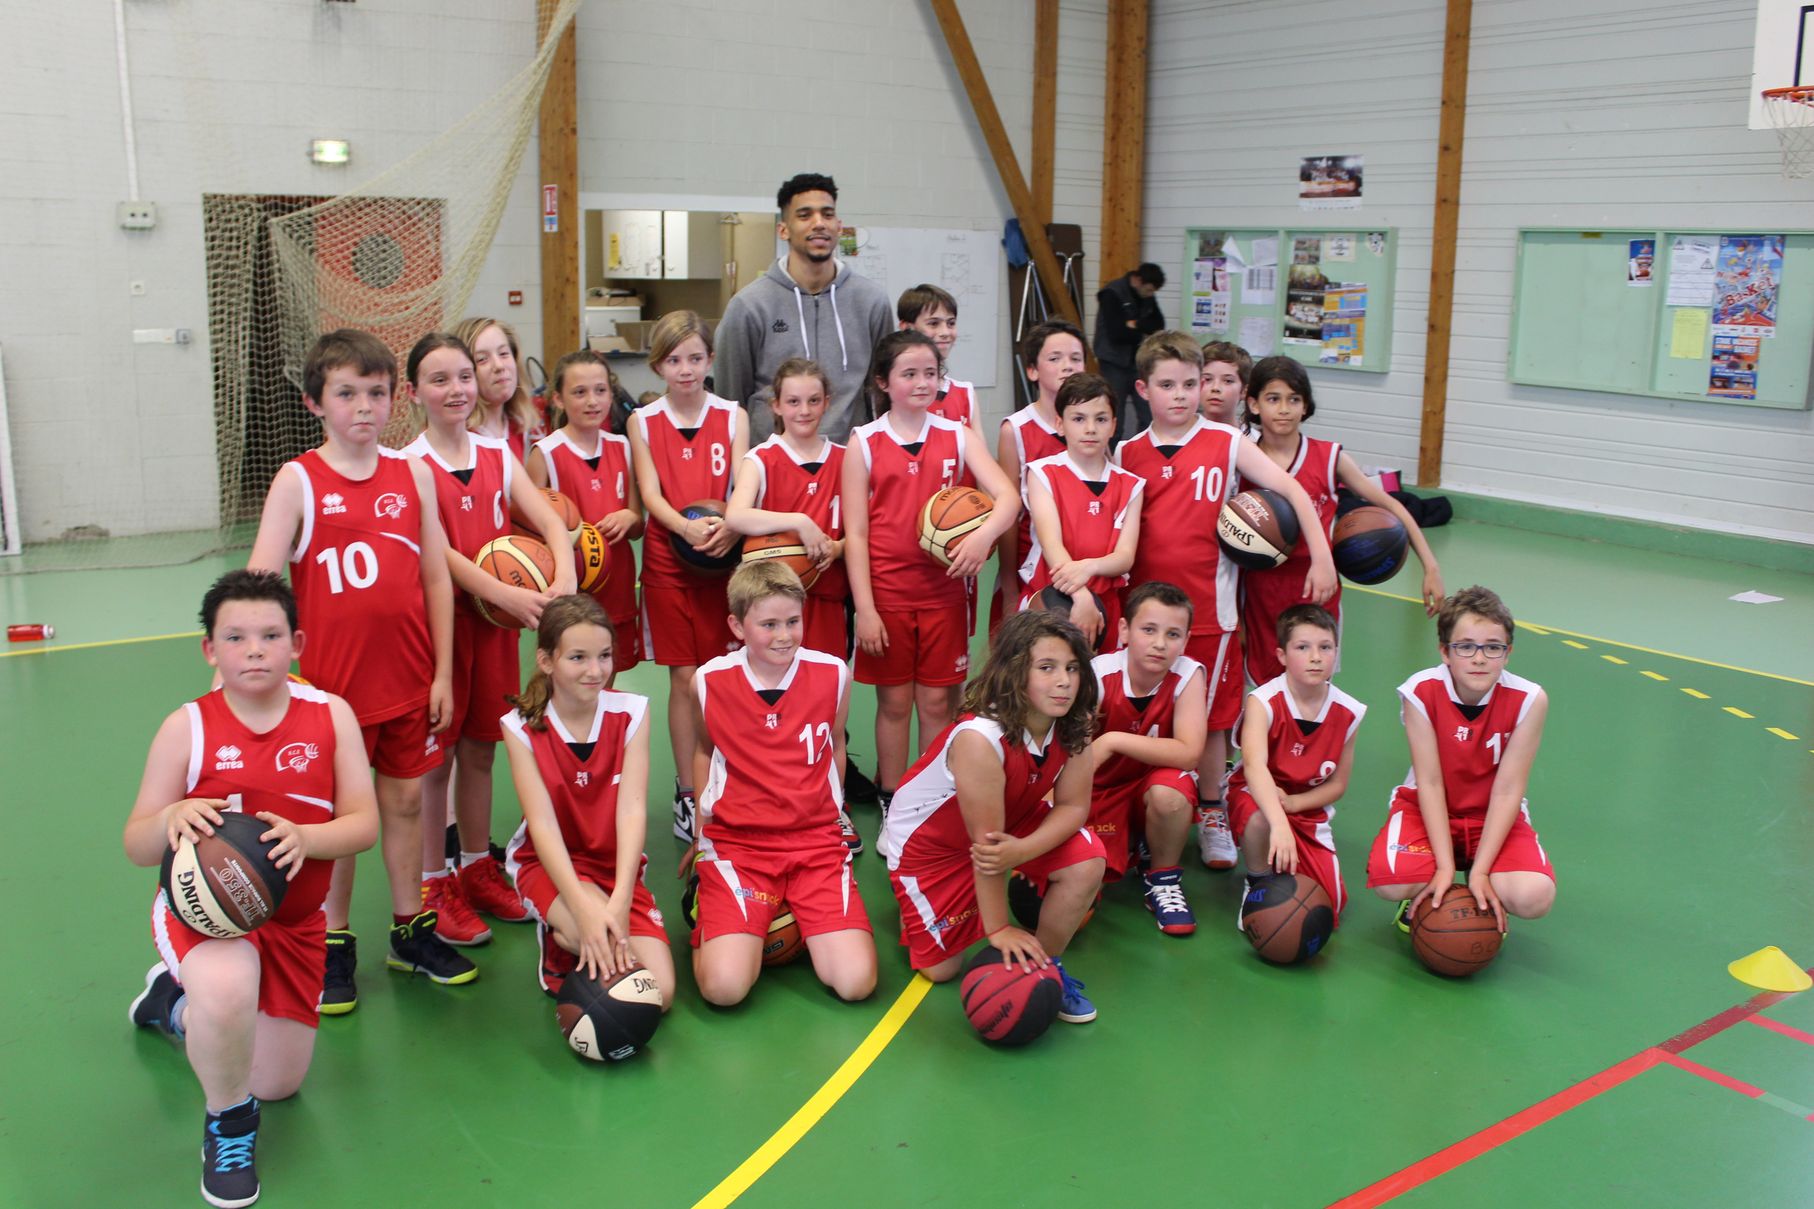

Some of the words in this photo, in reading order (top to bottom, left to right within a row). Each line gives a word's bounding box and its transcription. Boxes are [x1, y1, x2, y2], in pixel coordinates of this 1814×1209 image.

[710, 443, 726, 476] 8
[1191, 466, 1223, 502] 10
[316, 541, 379, 595] 10
[799, 721, 830, 766] 12
[177, 868, 236, 938] SPALDING
